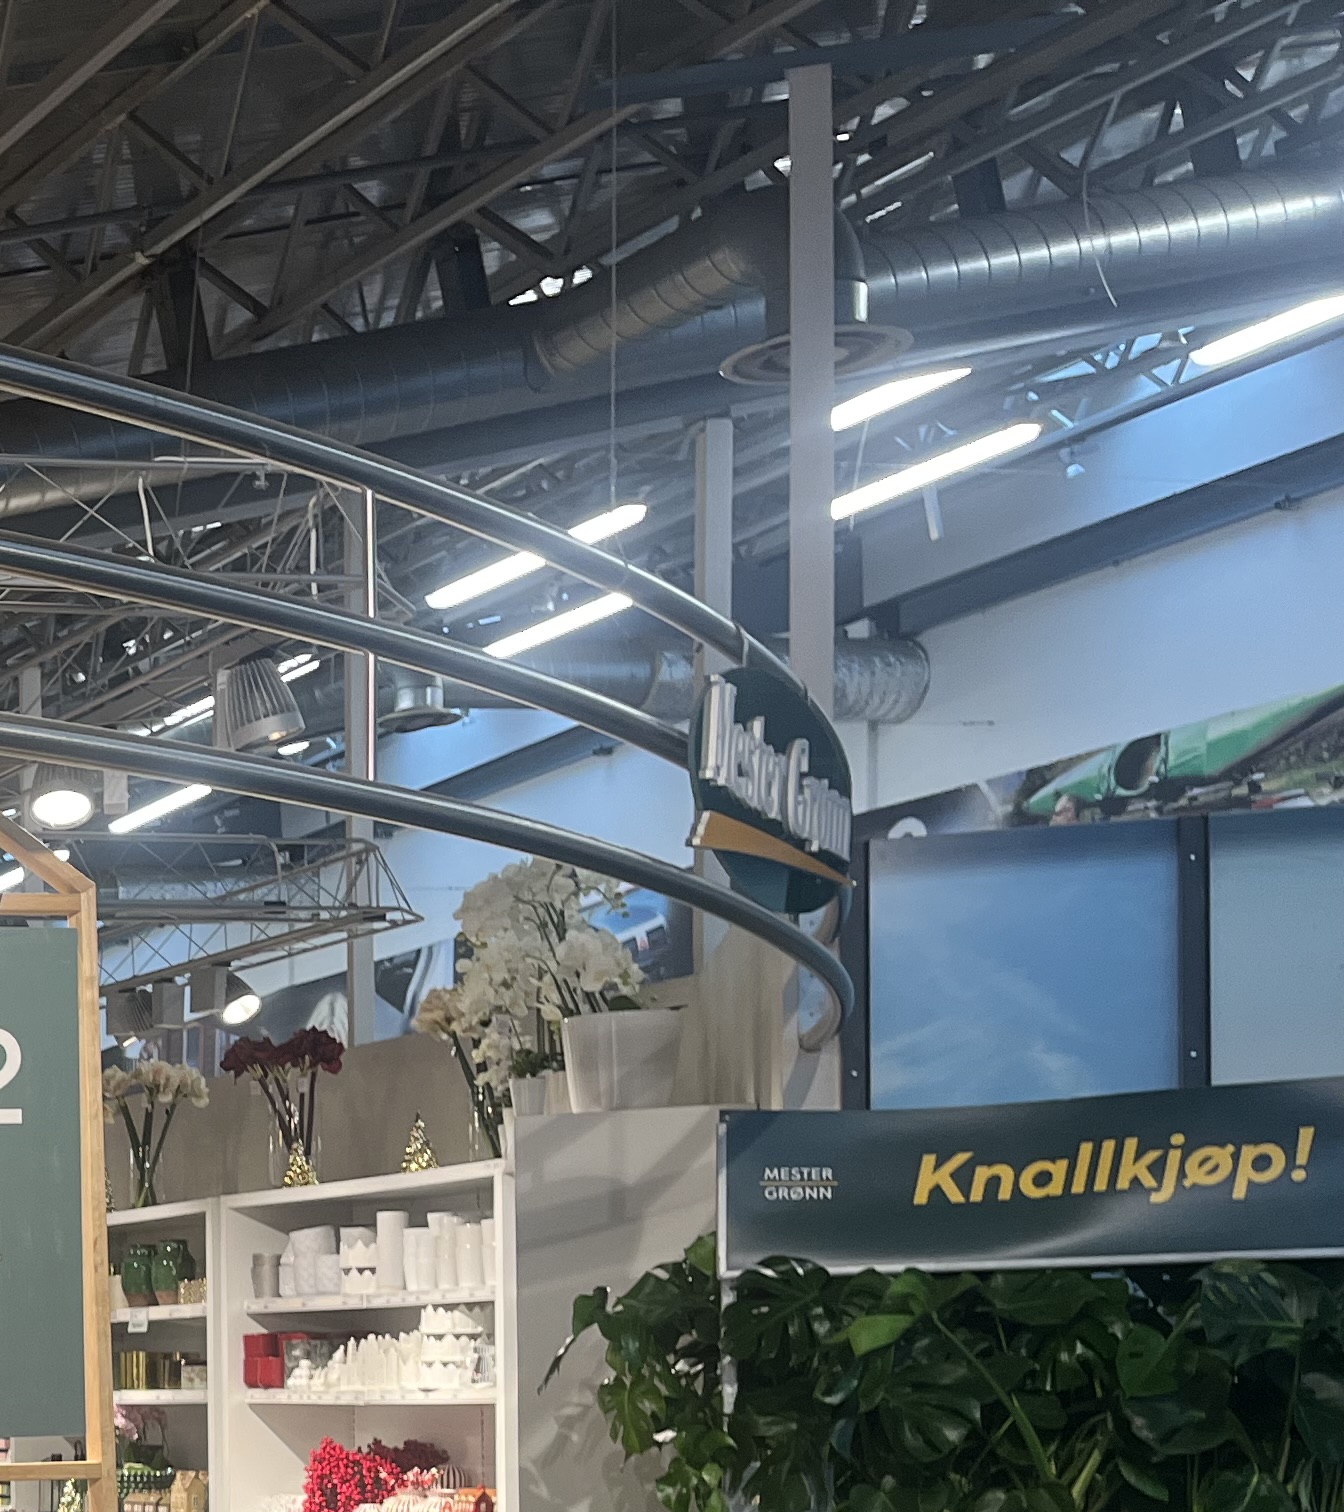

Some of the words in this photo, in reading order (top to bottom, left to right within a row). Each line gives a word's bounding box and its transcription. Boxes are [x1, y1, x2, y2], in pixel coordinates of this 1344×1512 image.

[764, 1166, 833, 1181] MESTER
[913, 1126, 1315, 1206] Knallkjøp!
[764, 1186, 832, 1200] GRØNN
